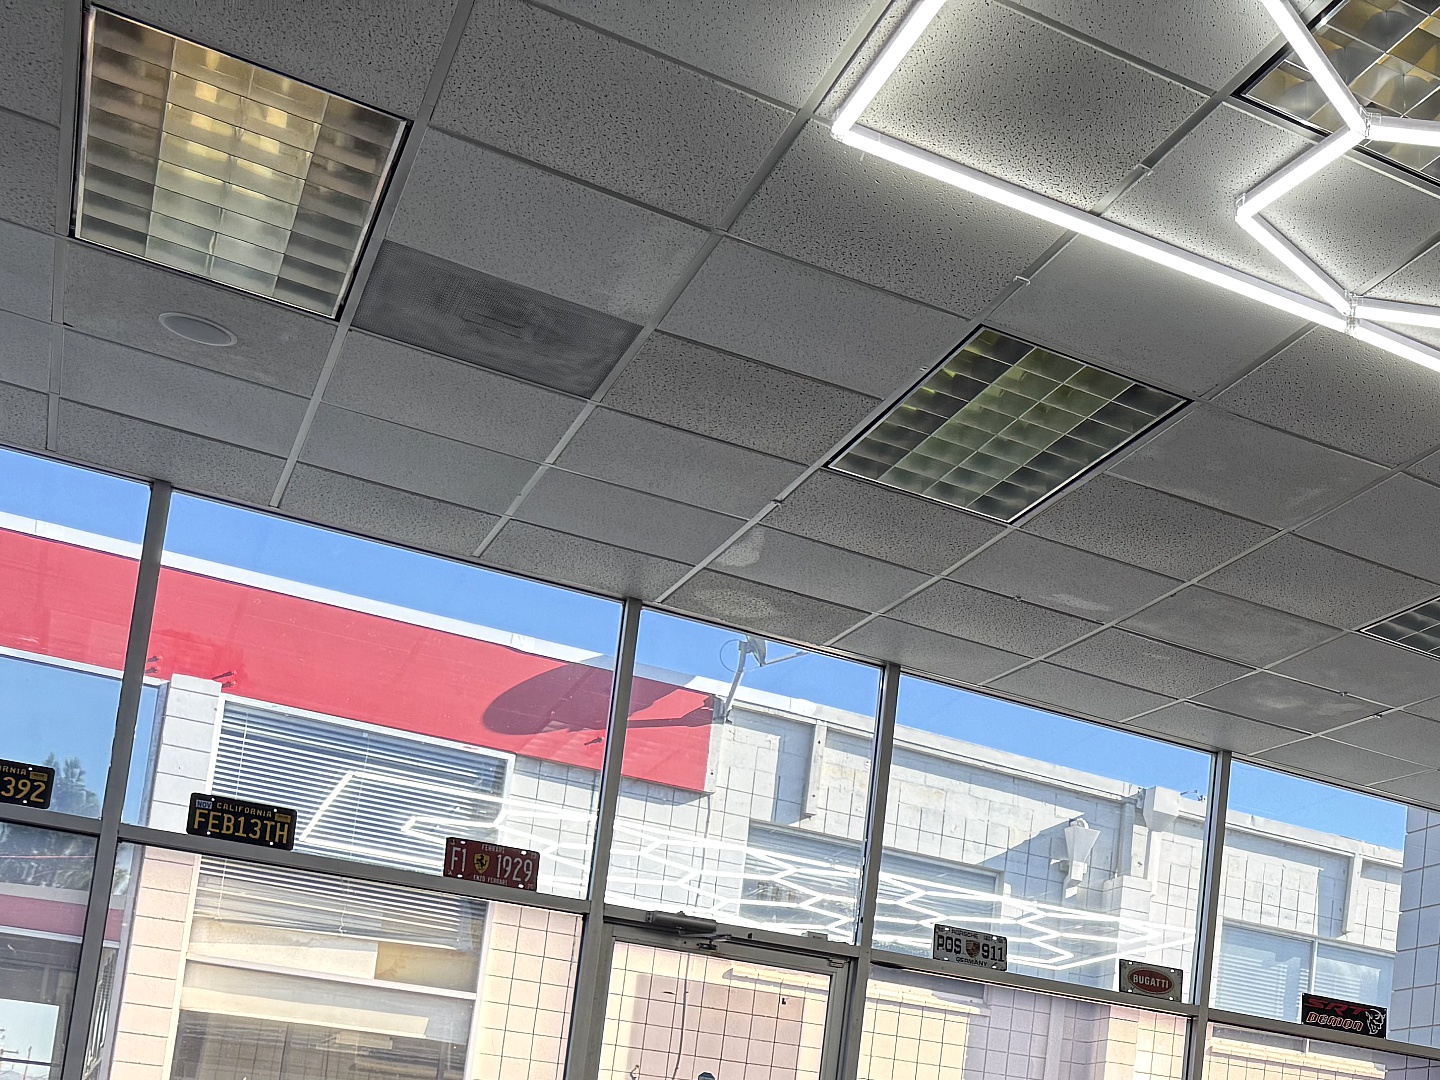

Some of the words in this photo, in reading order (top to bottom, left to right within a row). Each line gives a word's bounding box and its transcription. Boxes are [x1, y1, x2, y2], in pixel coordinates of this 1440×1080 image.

[0, 765, 27, 776] RNIA
[1, 776, 46, 803] 392
[216, 802, 272, 818] CALIFORNIA
[193, 809, 289, 844] FEB13TH
[481, 844, 505, 854] FERRARI
[450, 846, 467, 872] F1
[497, 854, 533, 882] 1929
[487, 877, 508, 887] FERRARI
[951, 928, 979, 940] PORSCHE
[936, 935, 962, 954] POS
[981, 943, 1005, 962] 911
[955, 956, 988, 967] GERMANY
[1133, 974, 1169, 989] BUGATTI
[1303, 997, 1371, 1016] SRT
